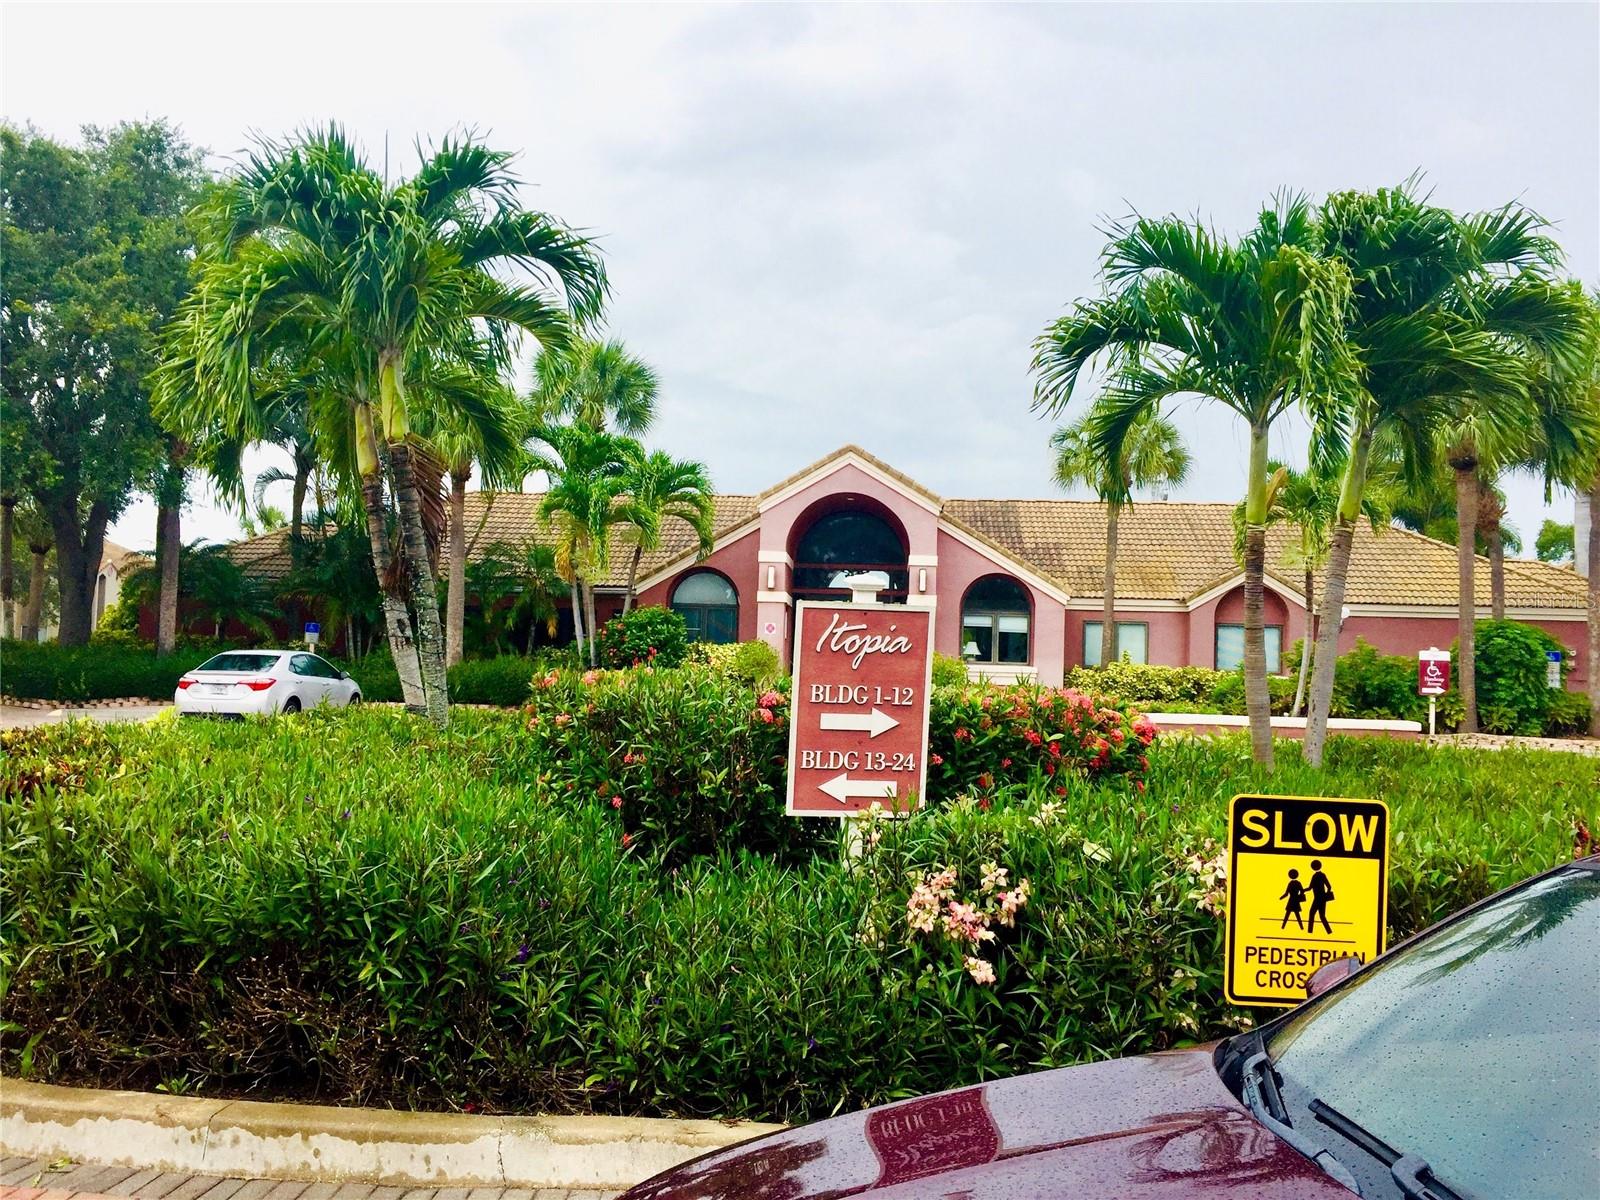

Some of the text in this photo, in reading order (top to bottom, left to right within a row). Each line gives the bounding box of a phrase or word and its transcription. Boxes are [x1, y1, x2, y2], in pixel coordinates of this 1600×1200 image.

[816, 612, 912, 669] Itopia
[810, 685, 913, 706] BLDG 1-12
[800, 751, 916, 772] BLDG 13-24
[1240, 809, 1378, 852] SLOW
[1256, 970, 1307, 990] CROS
